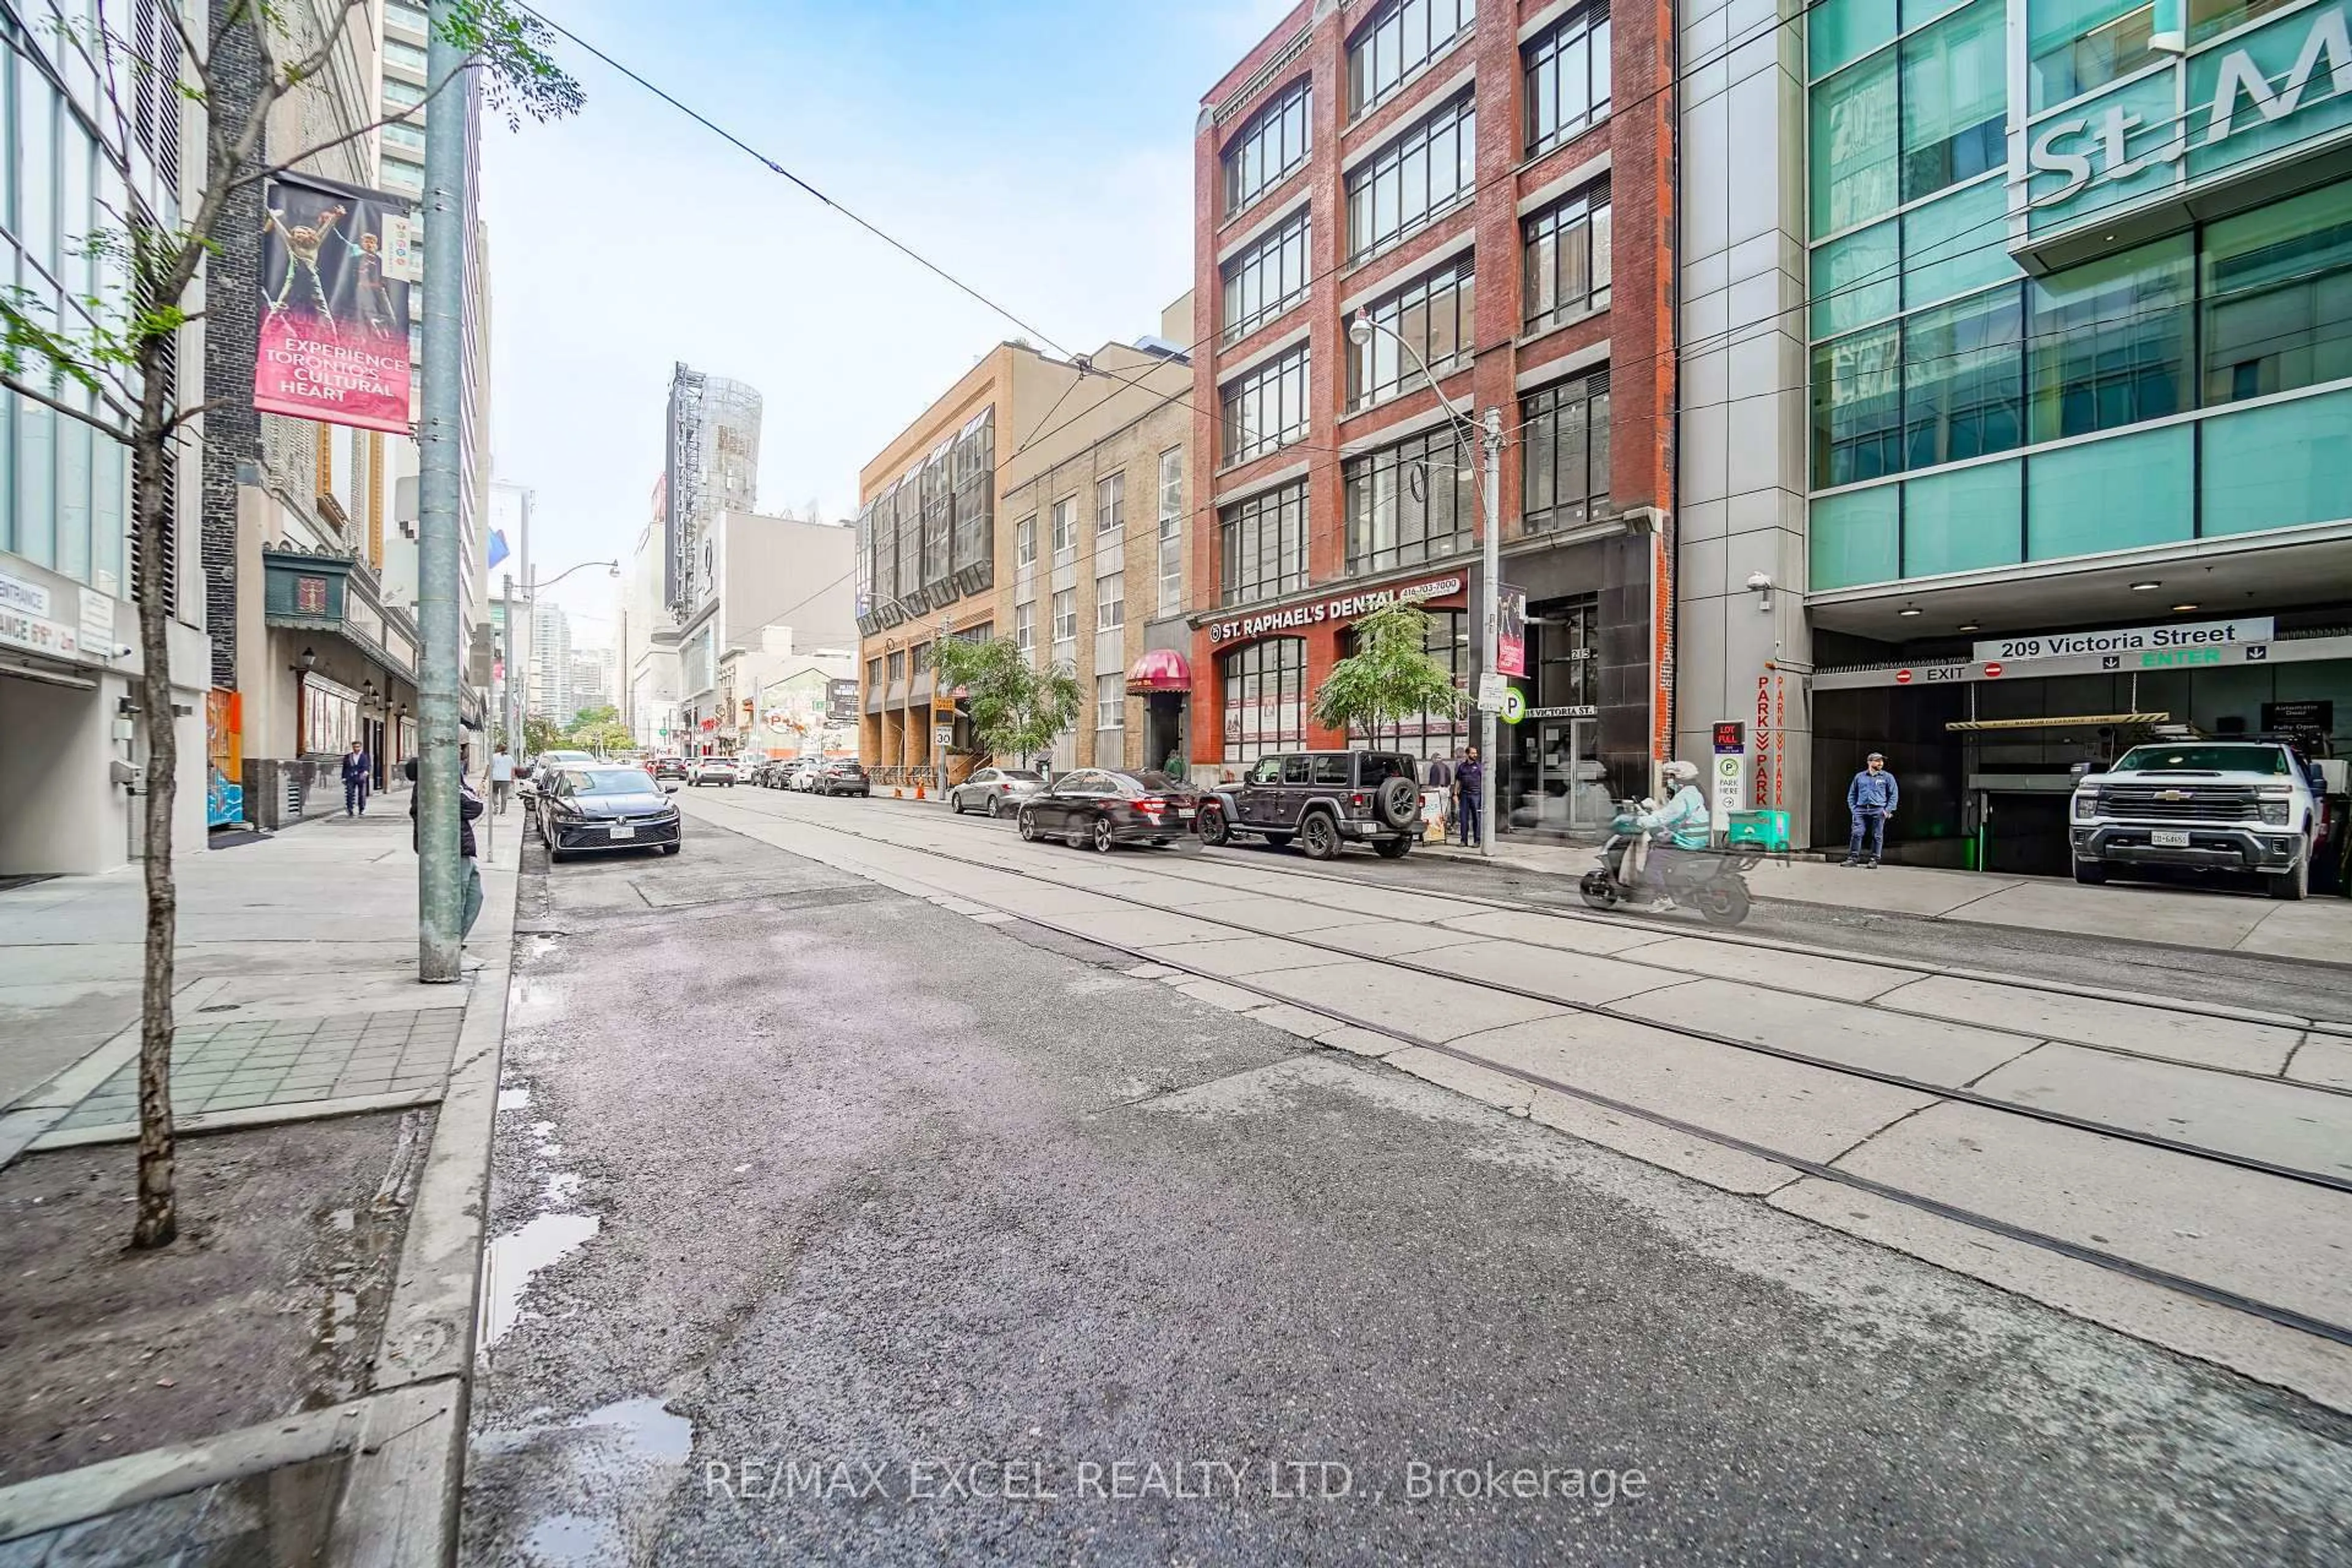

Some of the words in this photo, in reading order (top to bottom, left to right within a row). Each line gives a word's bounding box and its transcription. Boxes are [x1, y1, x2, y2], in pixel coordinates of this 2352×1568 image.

[2030, 105, 2183, 207] St.
[266, 349, 379, 380] TORONTO'S
[285, 338, 405, 372] EXPERIENCE
[280, 380, 347, 402] HEART
[294, 368, 394, 397] CULTURAL
[1404, 579, 1457, 596] 416-703-7000
[1221, 624, 1241, 638] ST.
[1243, 604, 1325, 634] RAPHAEL'S
[2002, 641, 2040, 657] 209
[2048, 633, 2144, 654] Victoria
[2152, 624, 2236, 646] Street
[2141, 647, 2222, 667] ENTER
[1927, 667, 1965, 681] EXIT
[1508, 698, 1518, 714] P
[1535, 707, 1577, 717] VICTORIA
[1579, 706, 1593, 715] ST.
[1757, 677, 1769, 727] PARK
[937, 734, 951, 743] 30
[1755, 754, 1768, 805] PARK
